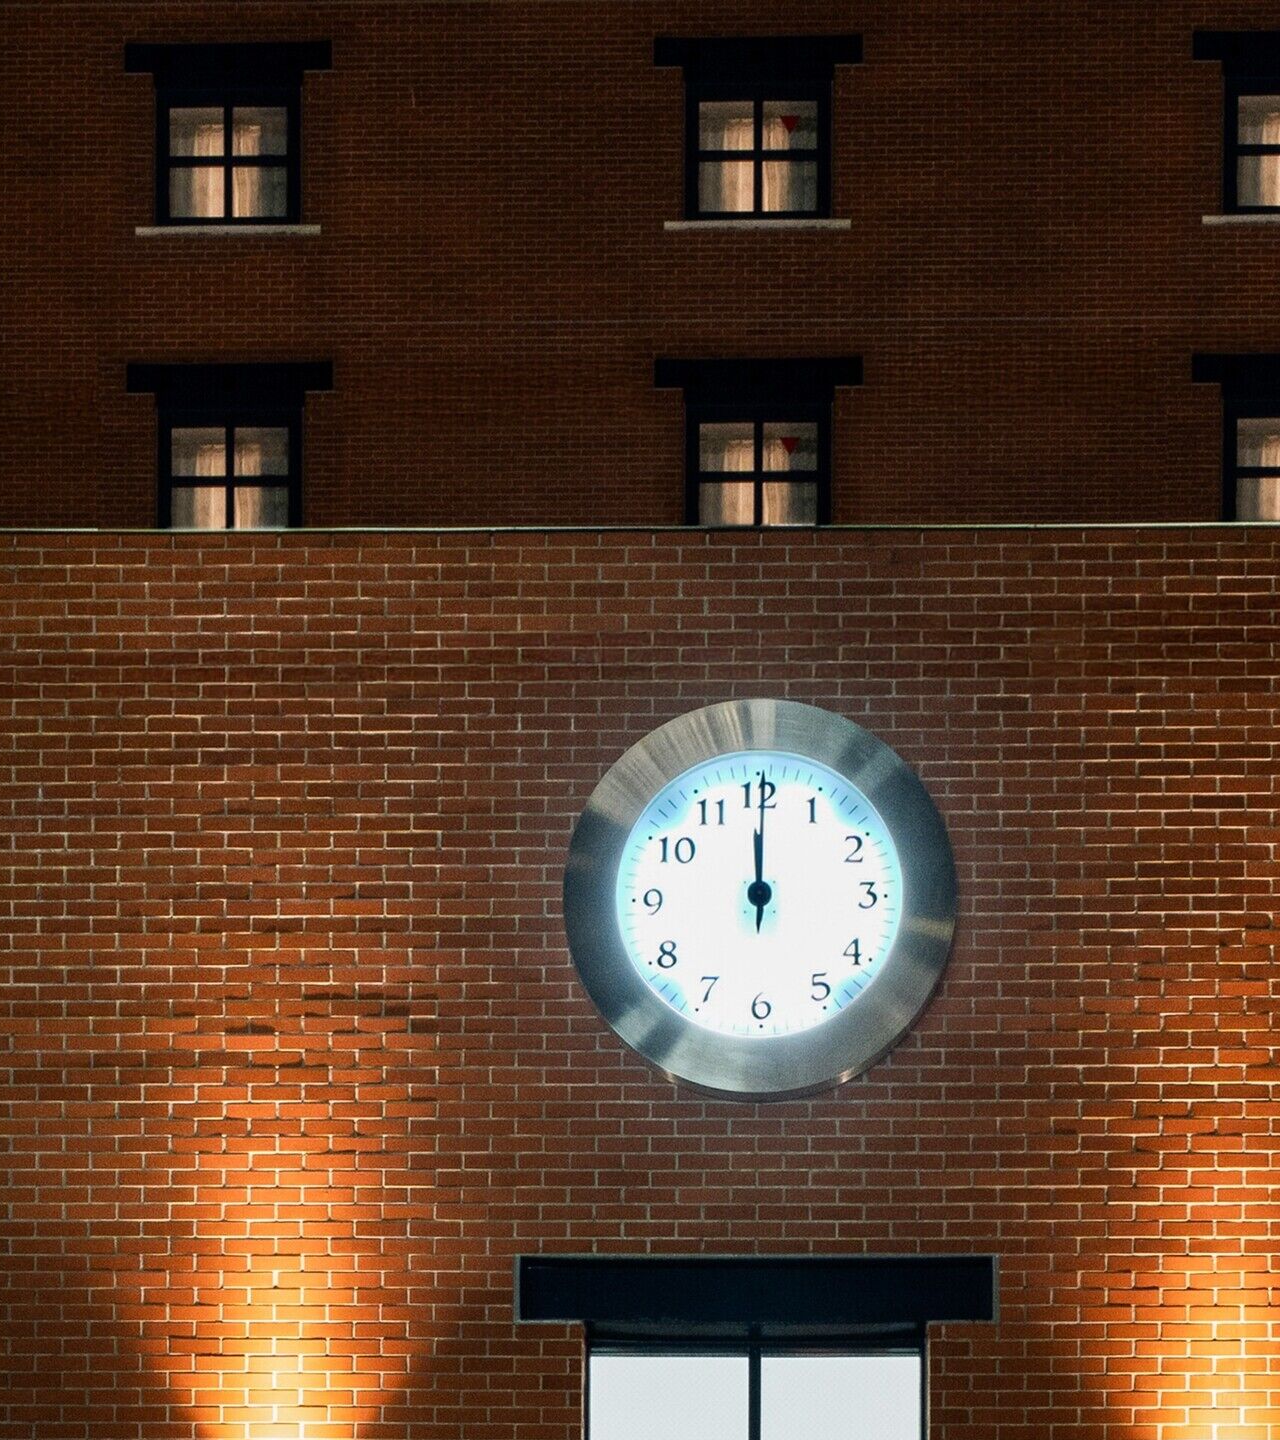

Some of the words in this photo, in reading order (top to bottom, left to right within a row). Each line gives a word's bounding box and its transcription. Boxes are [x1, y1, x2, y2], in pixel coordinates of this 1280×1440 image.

[742, 781, 777, 811] 12
[807, 796, 817, 824] 1
[697, 798, 725, 826] 11
[659, 836, 696, 864] 10
[844, 835, 864, 863] 2
[643, 888, 663, 916] 9
[858, 881, 878, 910] 3
[656, 940, 678, 969] 8
[842, 937, 862, 966] 4
[700, 976, 719, 1003] 7
[811, 972, 831, 1002] 5
[751, 992, 772, 1020] 6
